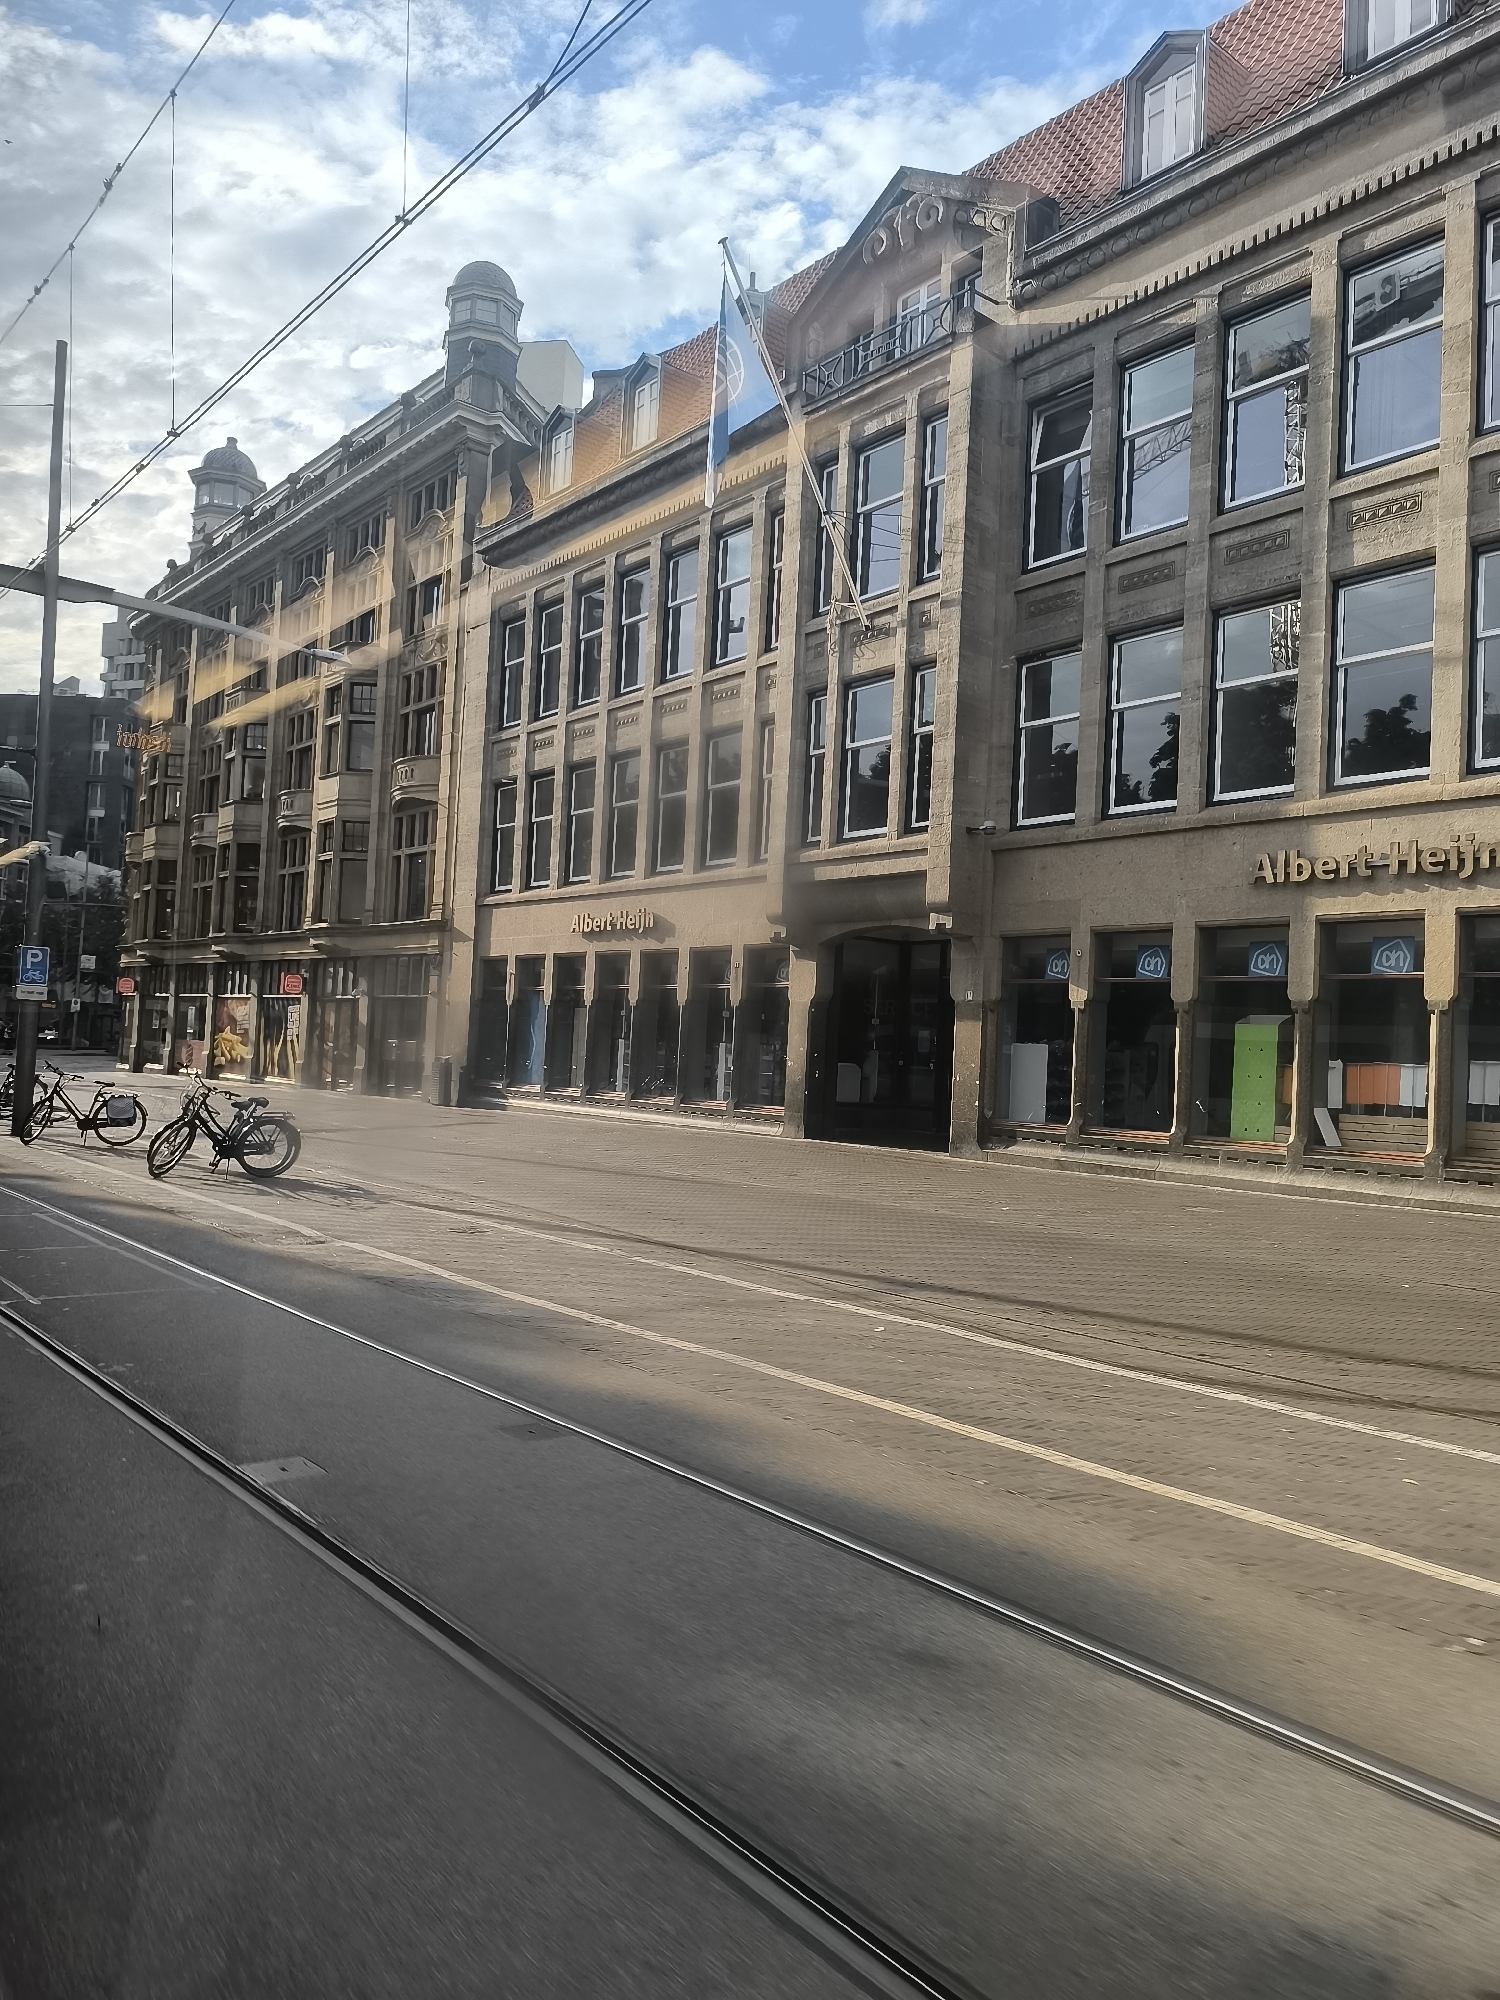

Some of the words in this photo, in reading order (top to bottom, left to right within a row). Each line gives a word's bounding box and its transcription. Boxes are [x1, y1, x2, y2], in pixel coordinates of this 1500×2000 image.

[1249, 845, 1375, 885] Albert
[1389, 833, 1500, 879] Heijn
[571, 911, 613, 933] Albert
[616, 908, 654, 933] Heijn
[26, 949, 43, 969] P
